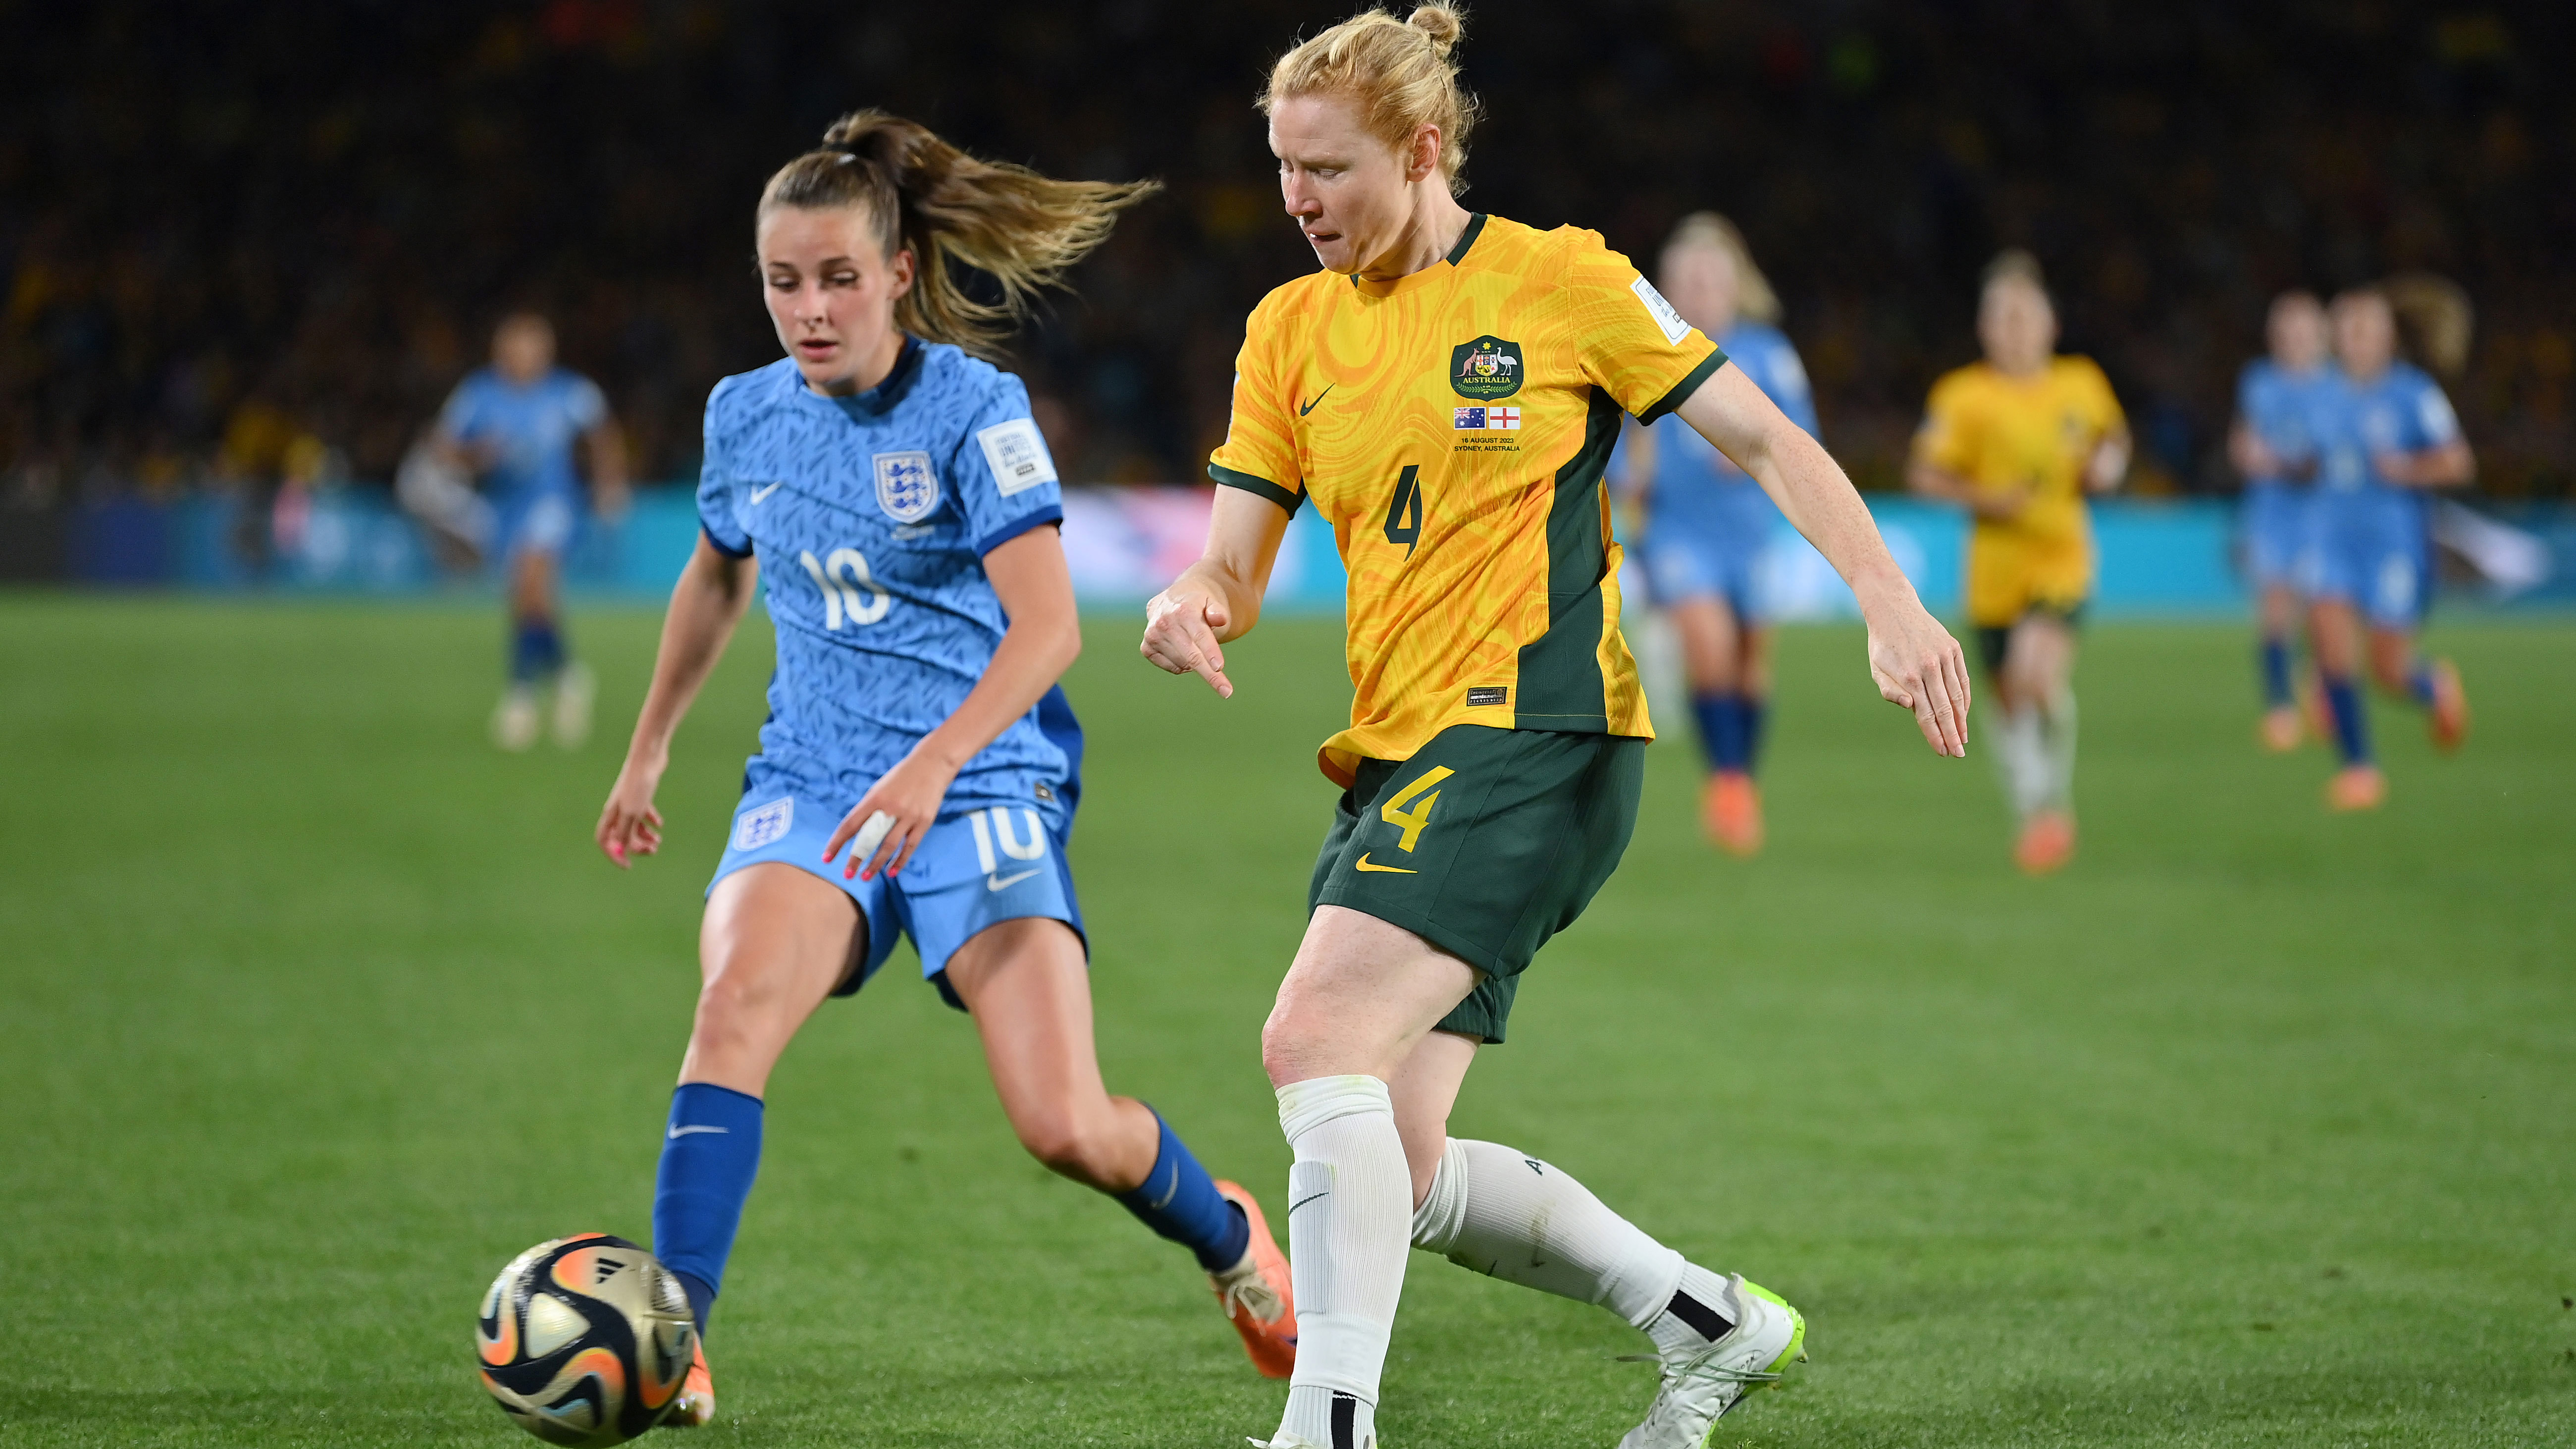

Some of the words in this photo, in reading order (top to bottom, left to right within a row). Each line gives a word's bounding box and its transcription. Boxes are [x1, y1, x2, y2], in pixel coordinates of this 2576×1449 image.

[1384, 465, 1422, 562] 4
[799, 548, 891, 631] 10
[969, 806, 1045, 874] 10
[1381, 765, 1456, 853] 4
